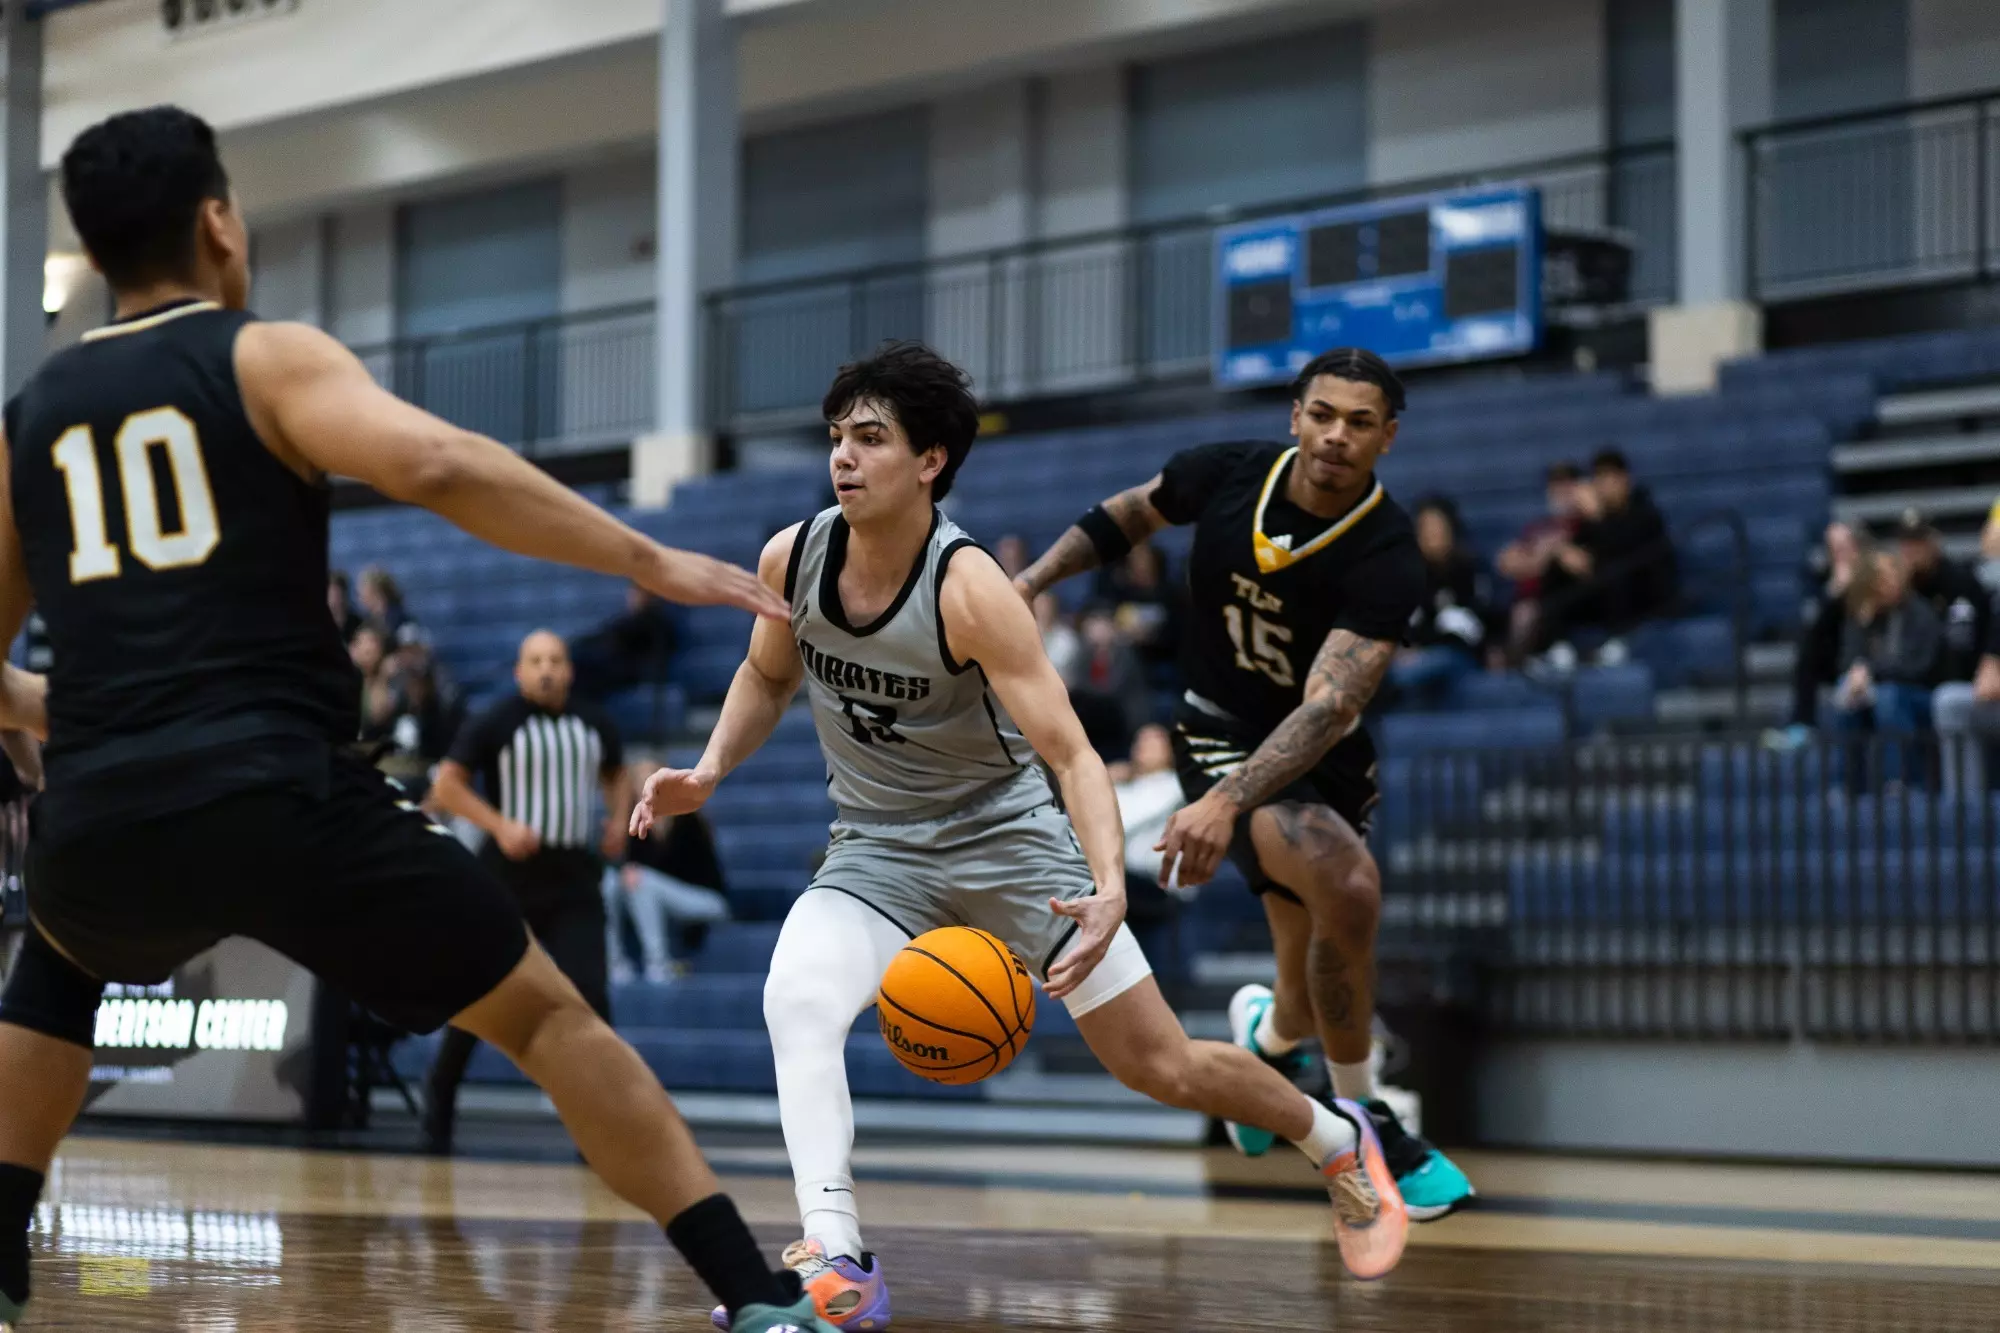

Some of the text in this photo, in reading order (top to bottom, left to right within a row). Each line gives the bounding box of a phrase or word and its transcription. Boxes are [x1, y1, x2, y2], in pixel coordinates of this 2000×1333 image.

[51, 405, 221, 585] 10
[800, 638, 931, 701] PIRATES
[1223, 604, 1296, 687] 15
[195, 999, 288, 1051] CENTER
